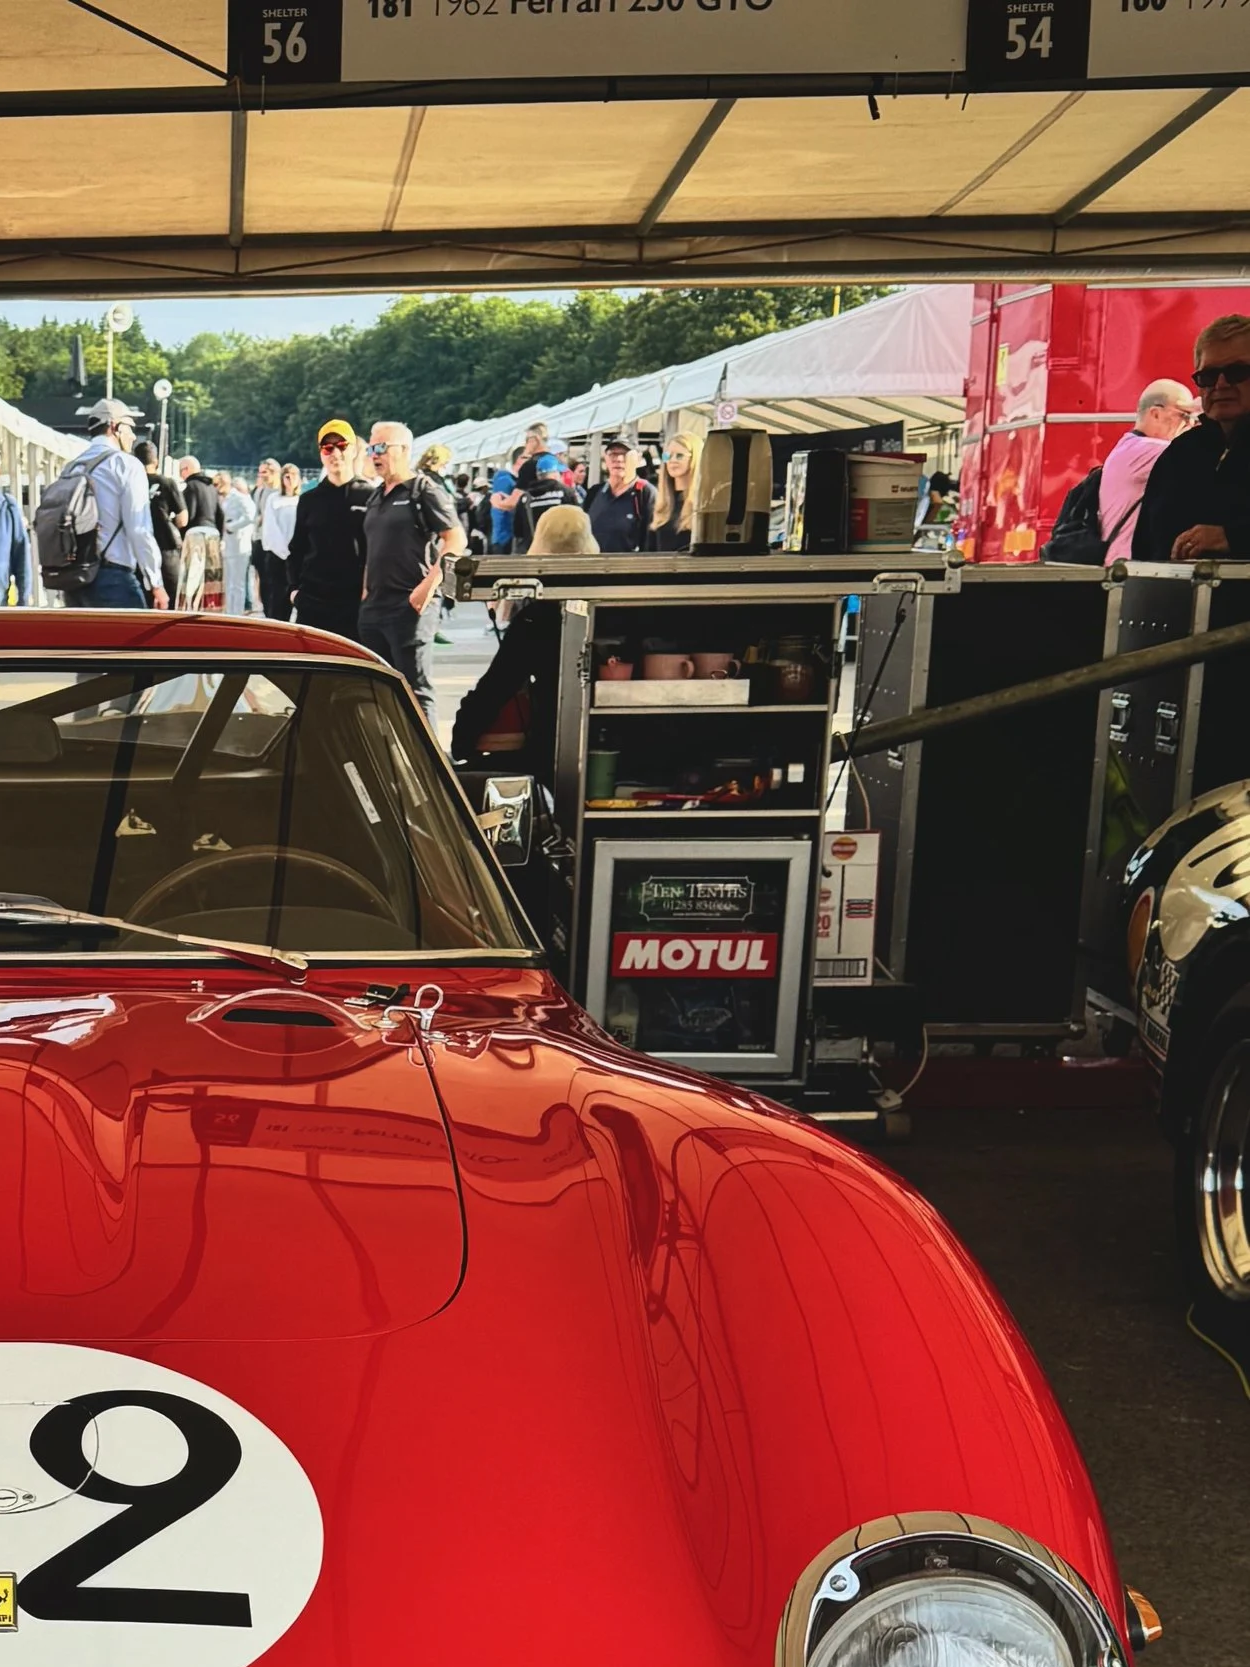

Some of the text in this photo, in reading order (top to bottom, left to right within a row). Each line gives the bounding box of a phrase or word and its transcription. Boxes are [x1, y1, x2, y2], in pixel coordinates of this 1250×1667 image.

[262, 8, 308, 18] SHELTER
[1007, 3, 1054, 13] SHELTER
[263, 21, 308, 64] 56
[1006, 16, 1053, 60] 54
[650, 884, 747, 898] TEN TENTHS
[619, 938, 769, 971] MOTUL
